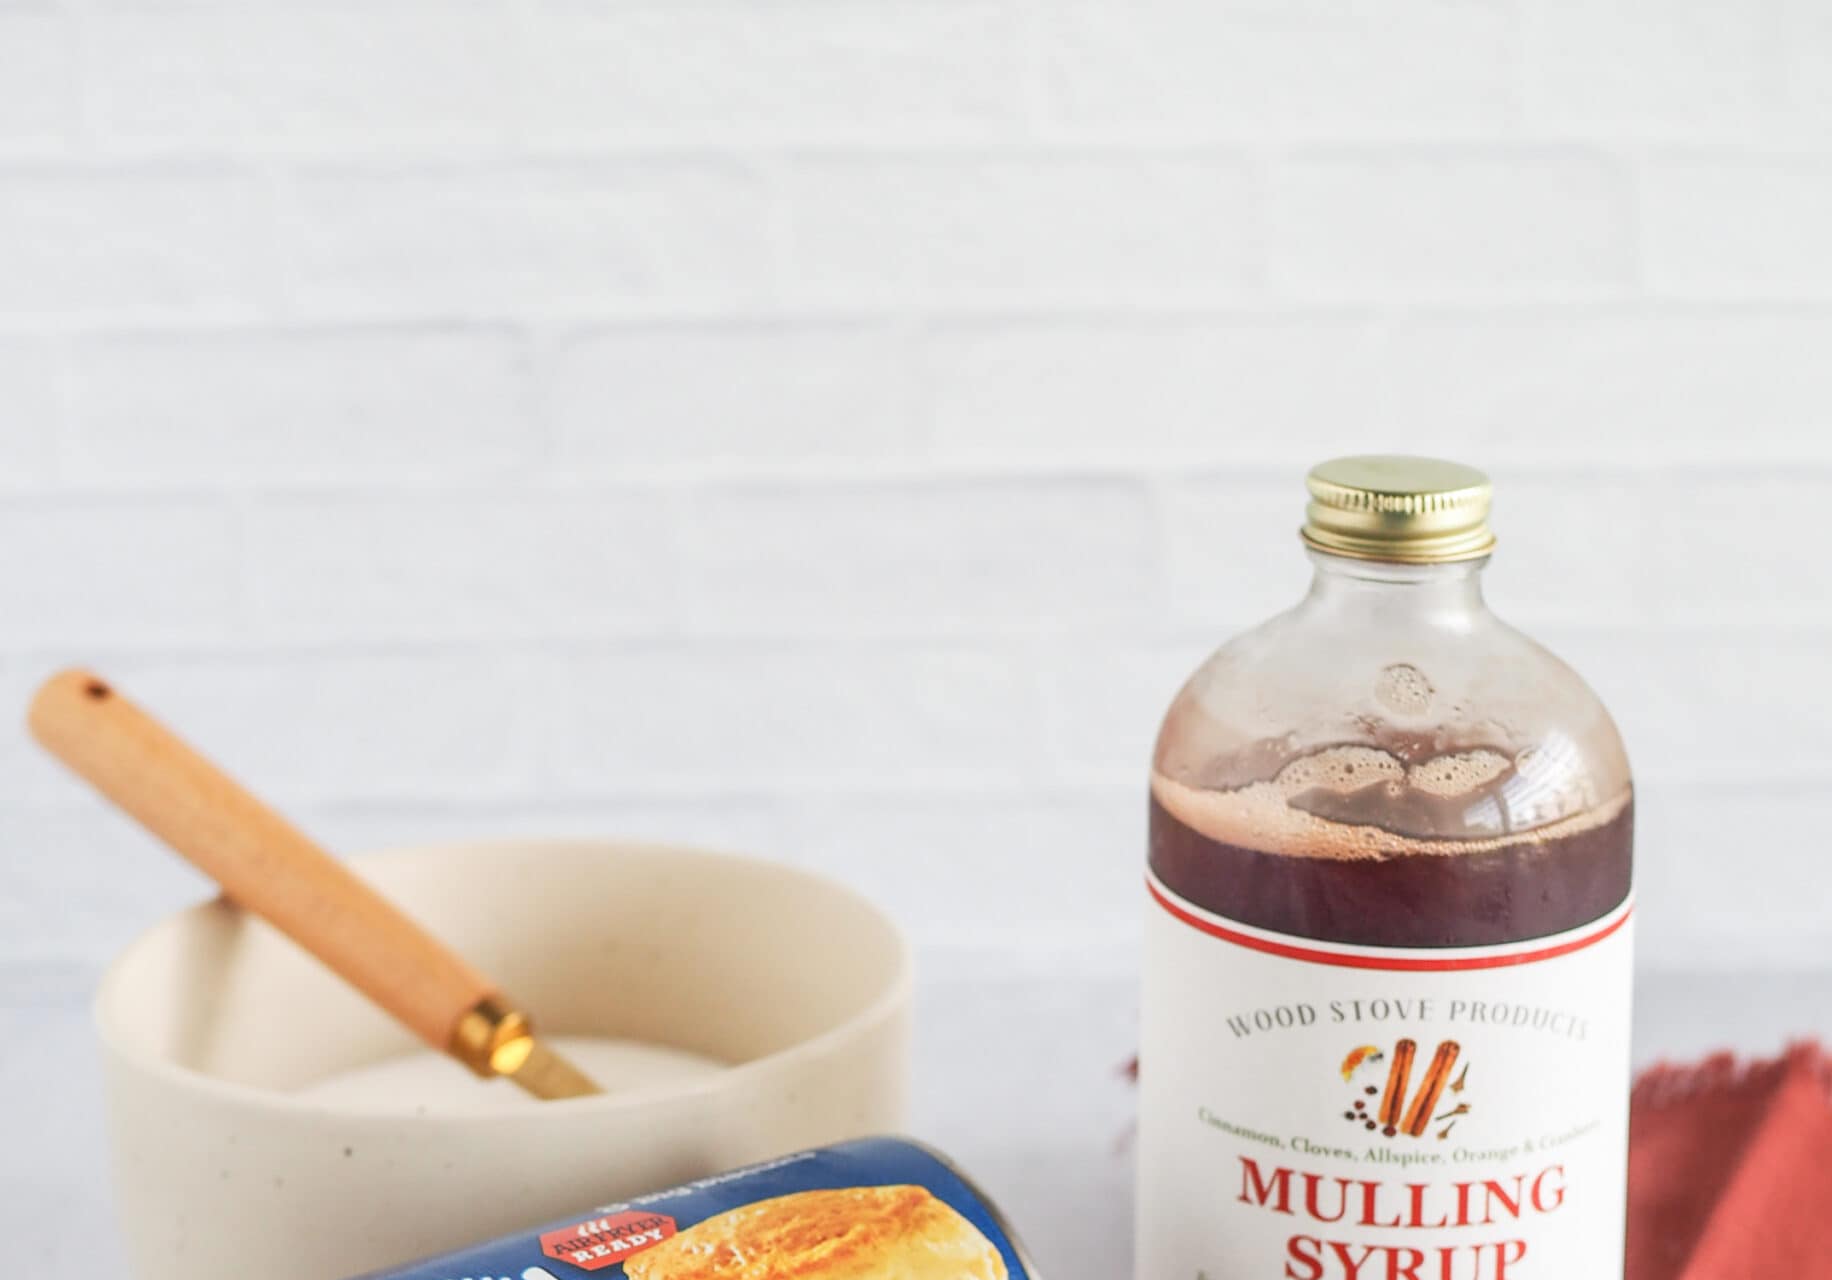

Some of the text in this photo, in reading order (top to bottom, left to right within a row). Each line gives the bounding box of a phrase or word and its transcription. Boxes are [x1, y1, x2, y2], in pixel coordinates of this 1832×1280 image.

[1226, 999, 1590, 1041] WOOD STOVE PRODUCTS
[1237, 1155, 1567, 1229] MULLING
[571, 1228, 663, 1263] READY
